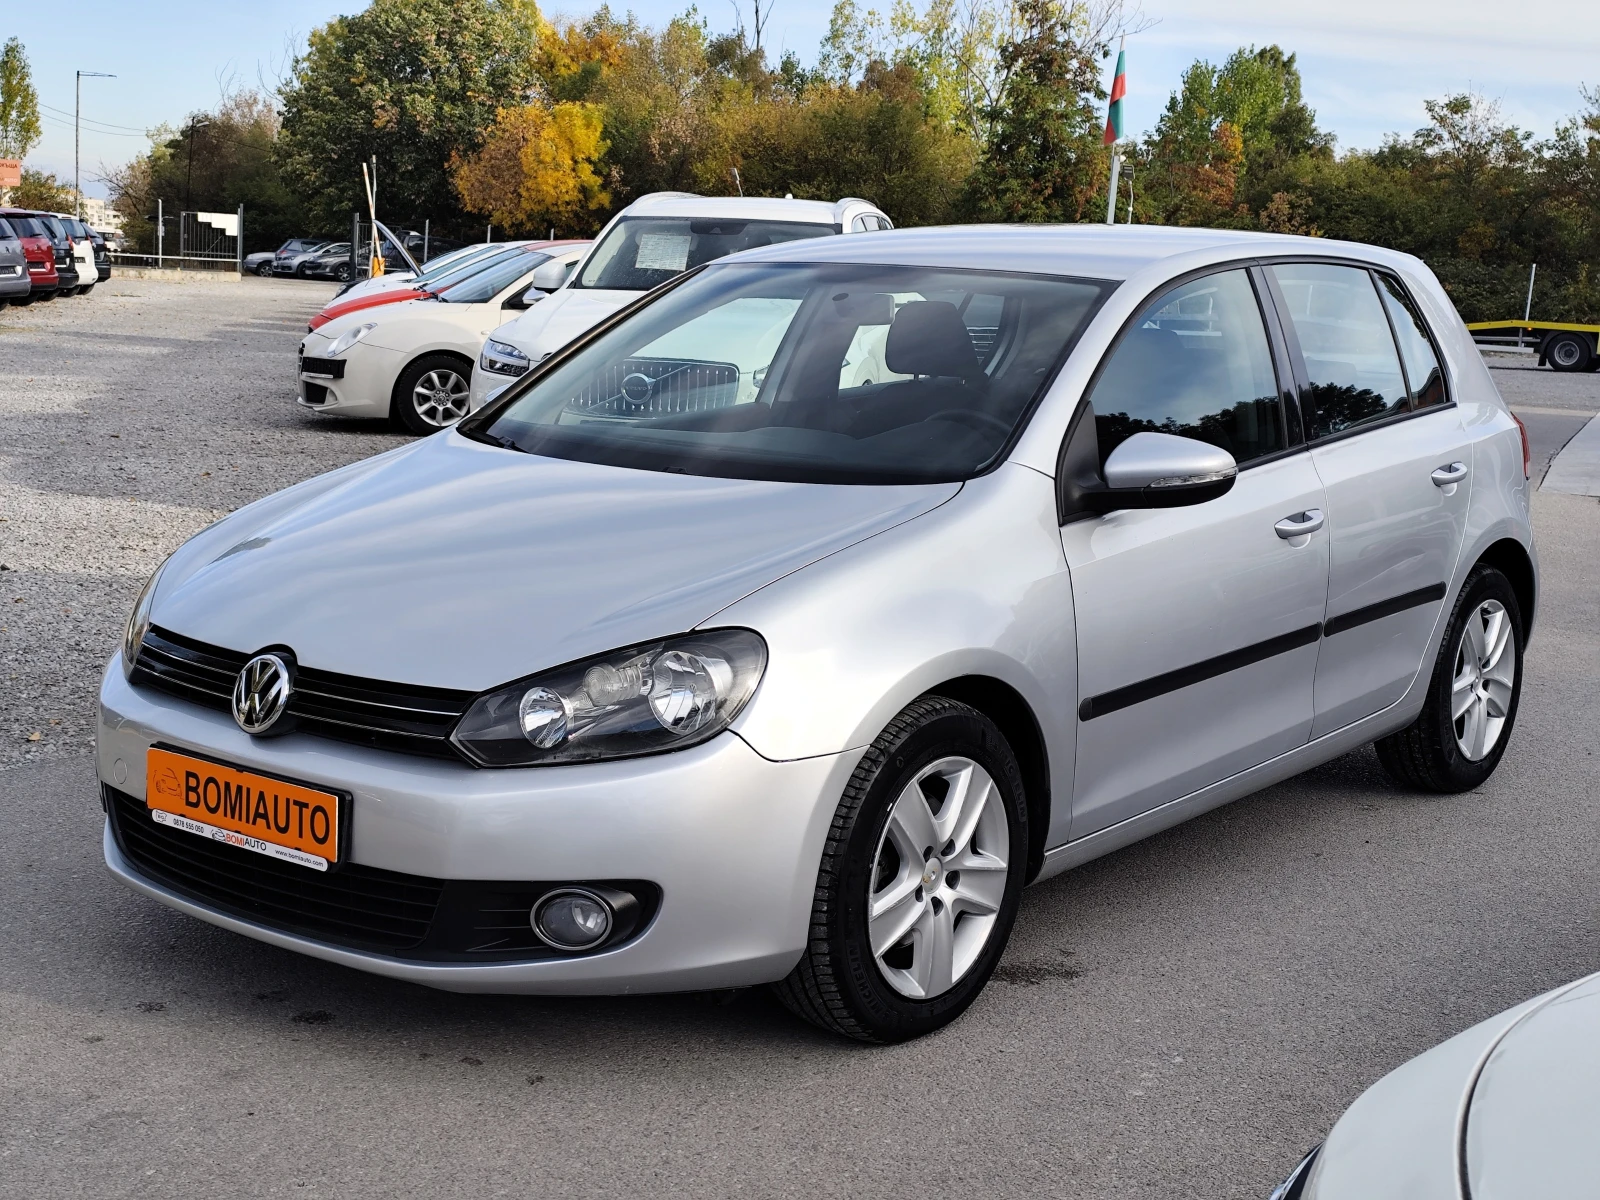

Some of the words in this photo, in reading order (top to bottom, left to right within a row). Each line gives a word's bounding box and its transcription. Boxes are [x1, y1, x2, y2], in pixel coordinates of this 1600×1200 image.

[184, 770, 330, 845] BOMIAUTO
[225, 833, 267, 851] BOMIAUTO
[275, 849, 324, 867] www.bomiauto.com
